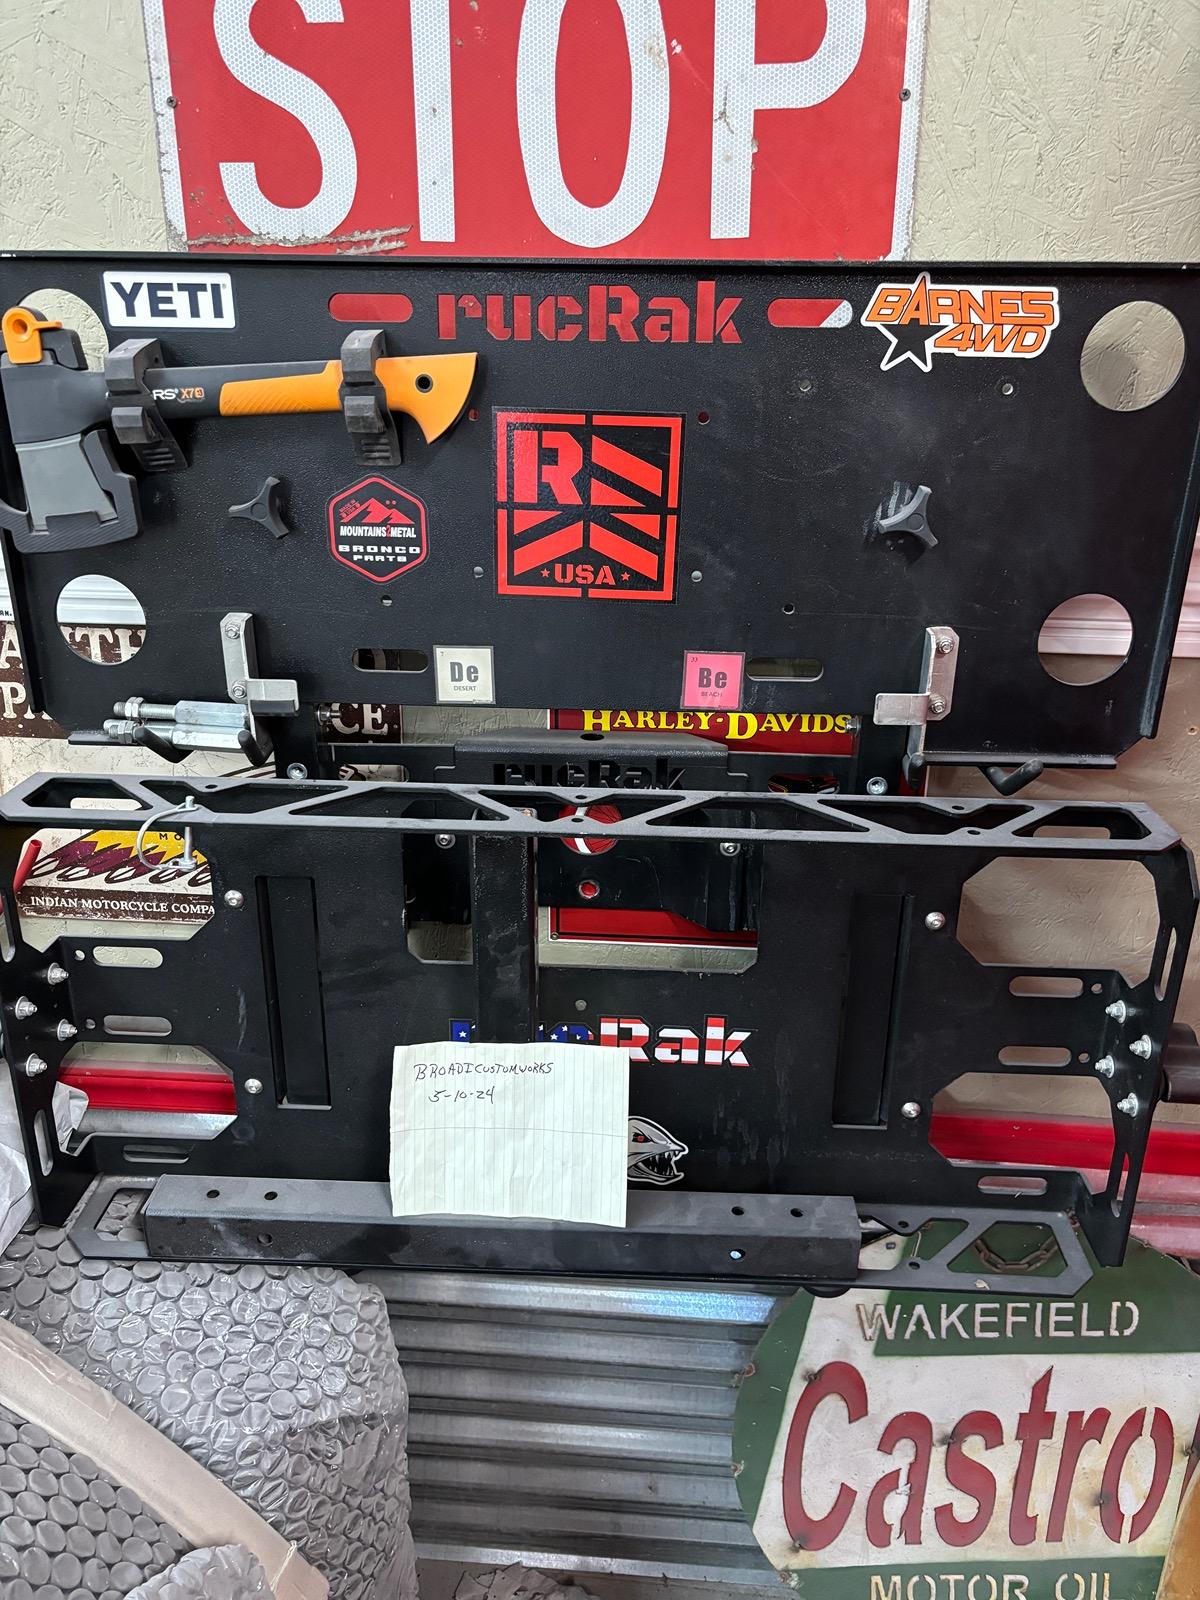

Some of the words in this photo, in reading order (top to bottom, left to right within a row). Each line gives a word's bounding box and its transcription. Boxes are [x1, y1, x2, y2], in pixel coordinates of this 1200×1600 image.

[109, 281, 225, 319] YETI
[437, 280, 743, 344] rucRak
[864, 275, 1055, 326] BARNES
[933, 322, 1047, 354] 4WD
[338, 545, 420, 554] BRONCO
[554, 563, 616, 585] USA
[449, 661, 479, 683] De
[698, 667, 728, 689] Be
[30, 896, 78, 908] INDIAN
[81, 899, 168, 913] MOTORCYCLE
[855, 1300, 1140, 1342] WAKEFIELD
[781, 1360, 1200, 1552] Castro
[869, 1573, 1030, 1600] MOTOR
